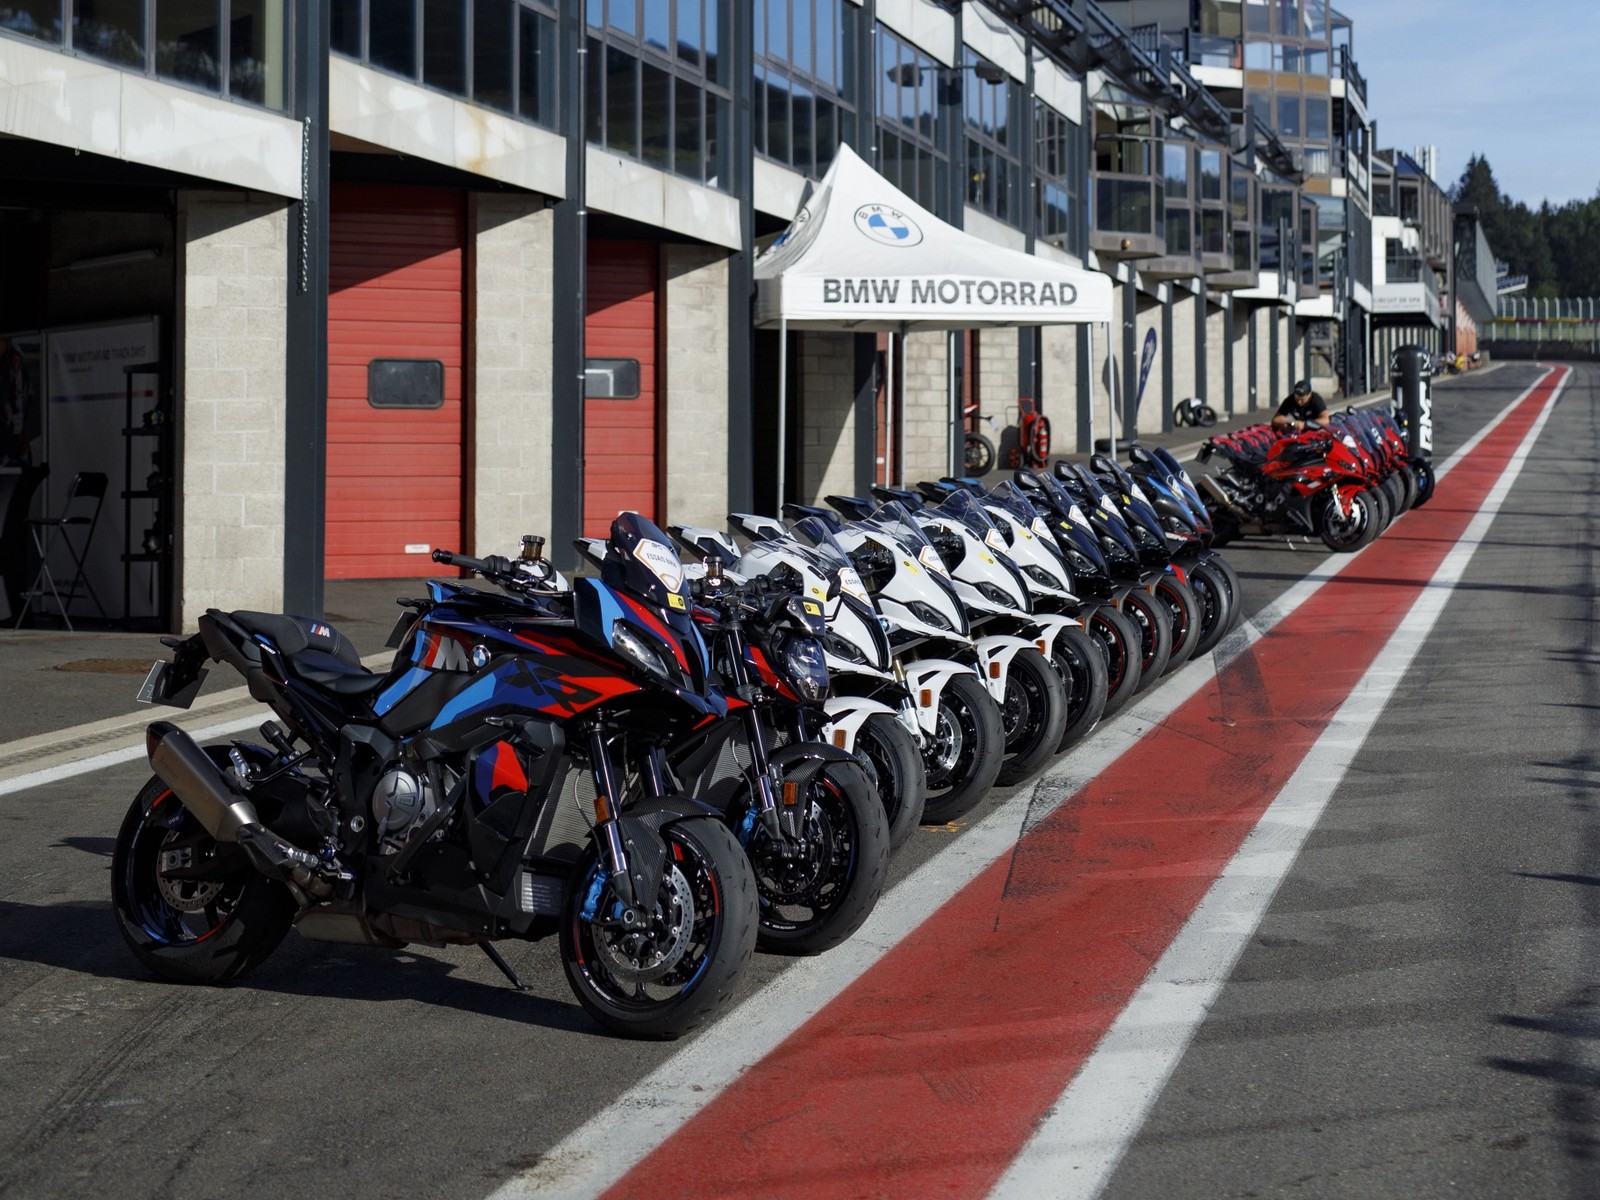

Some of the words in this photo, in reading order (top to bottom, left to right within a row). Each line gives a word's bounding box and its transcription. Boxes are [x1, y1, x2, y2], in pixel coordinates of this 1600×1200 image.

[859, 206, 902, 220] BMW
[823, 279, 900, 303] BMW
[911, 279, 1078, 306] MOTORRAD
